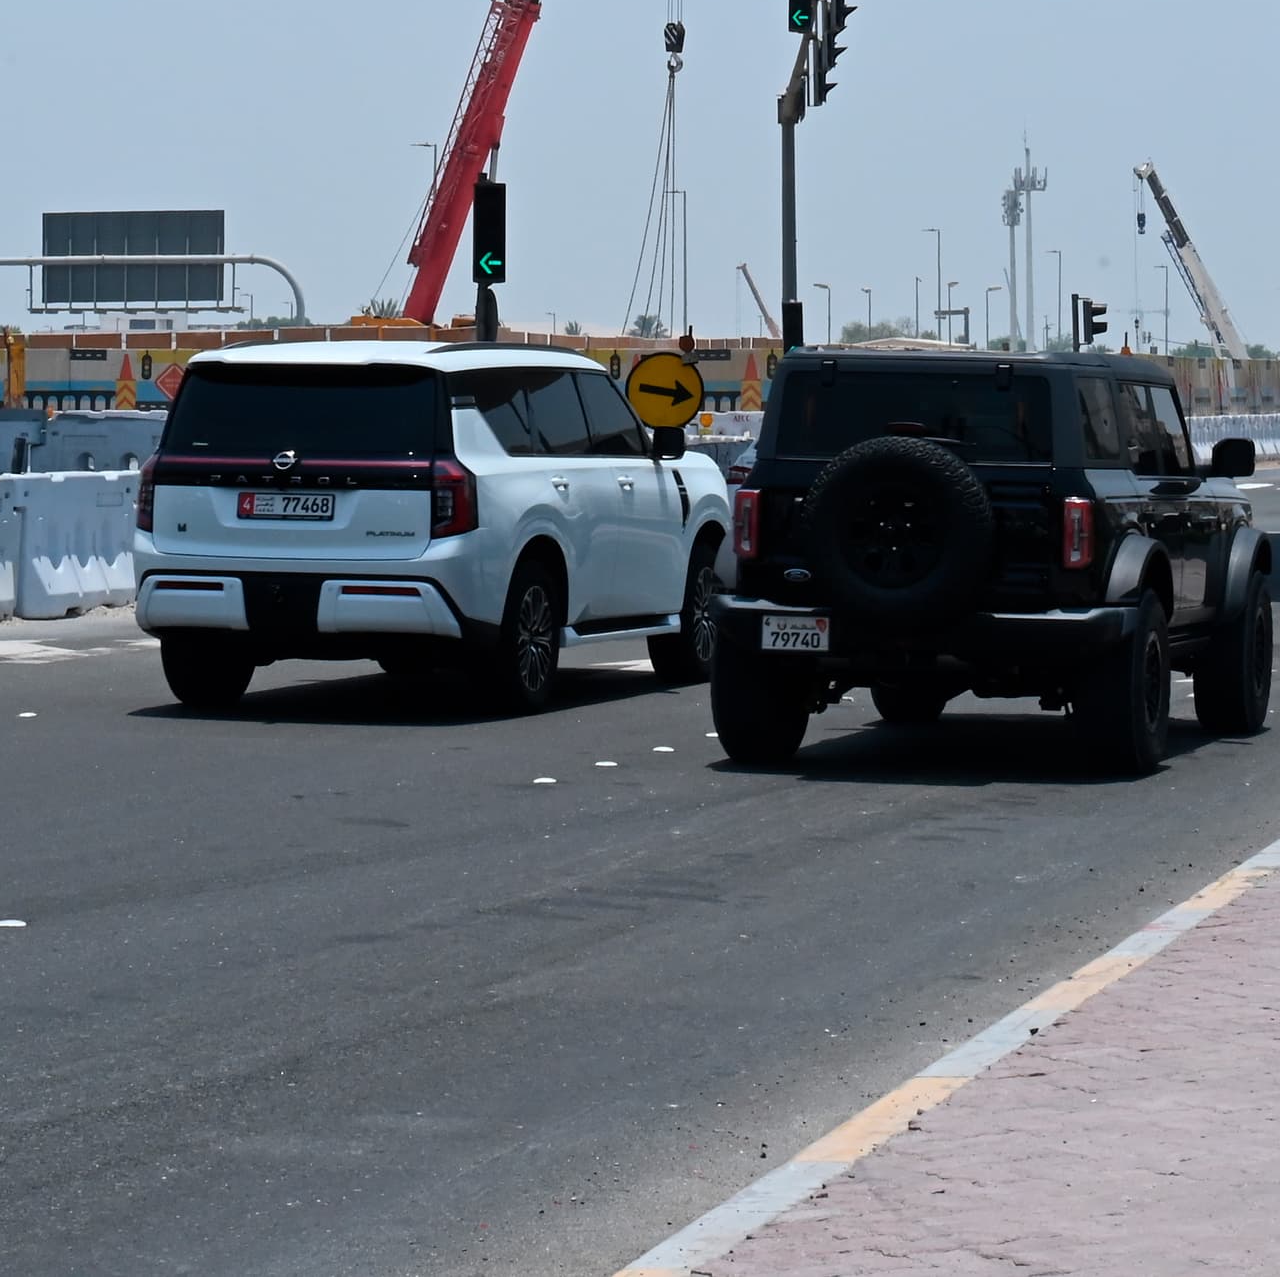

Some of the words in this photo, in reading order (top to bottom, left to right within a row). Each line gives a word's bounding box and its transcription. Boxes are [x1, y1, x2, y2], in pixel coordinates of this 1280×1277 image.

[210, 475, 358, 485] PATROL
[243, 498, 251, 510] 4
[282, 497, 330, 514] 77468
[764, 617, 771, 627] 4
[770, 631, 821, 649] 79740
